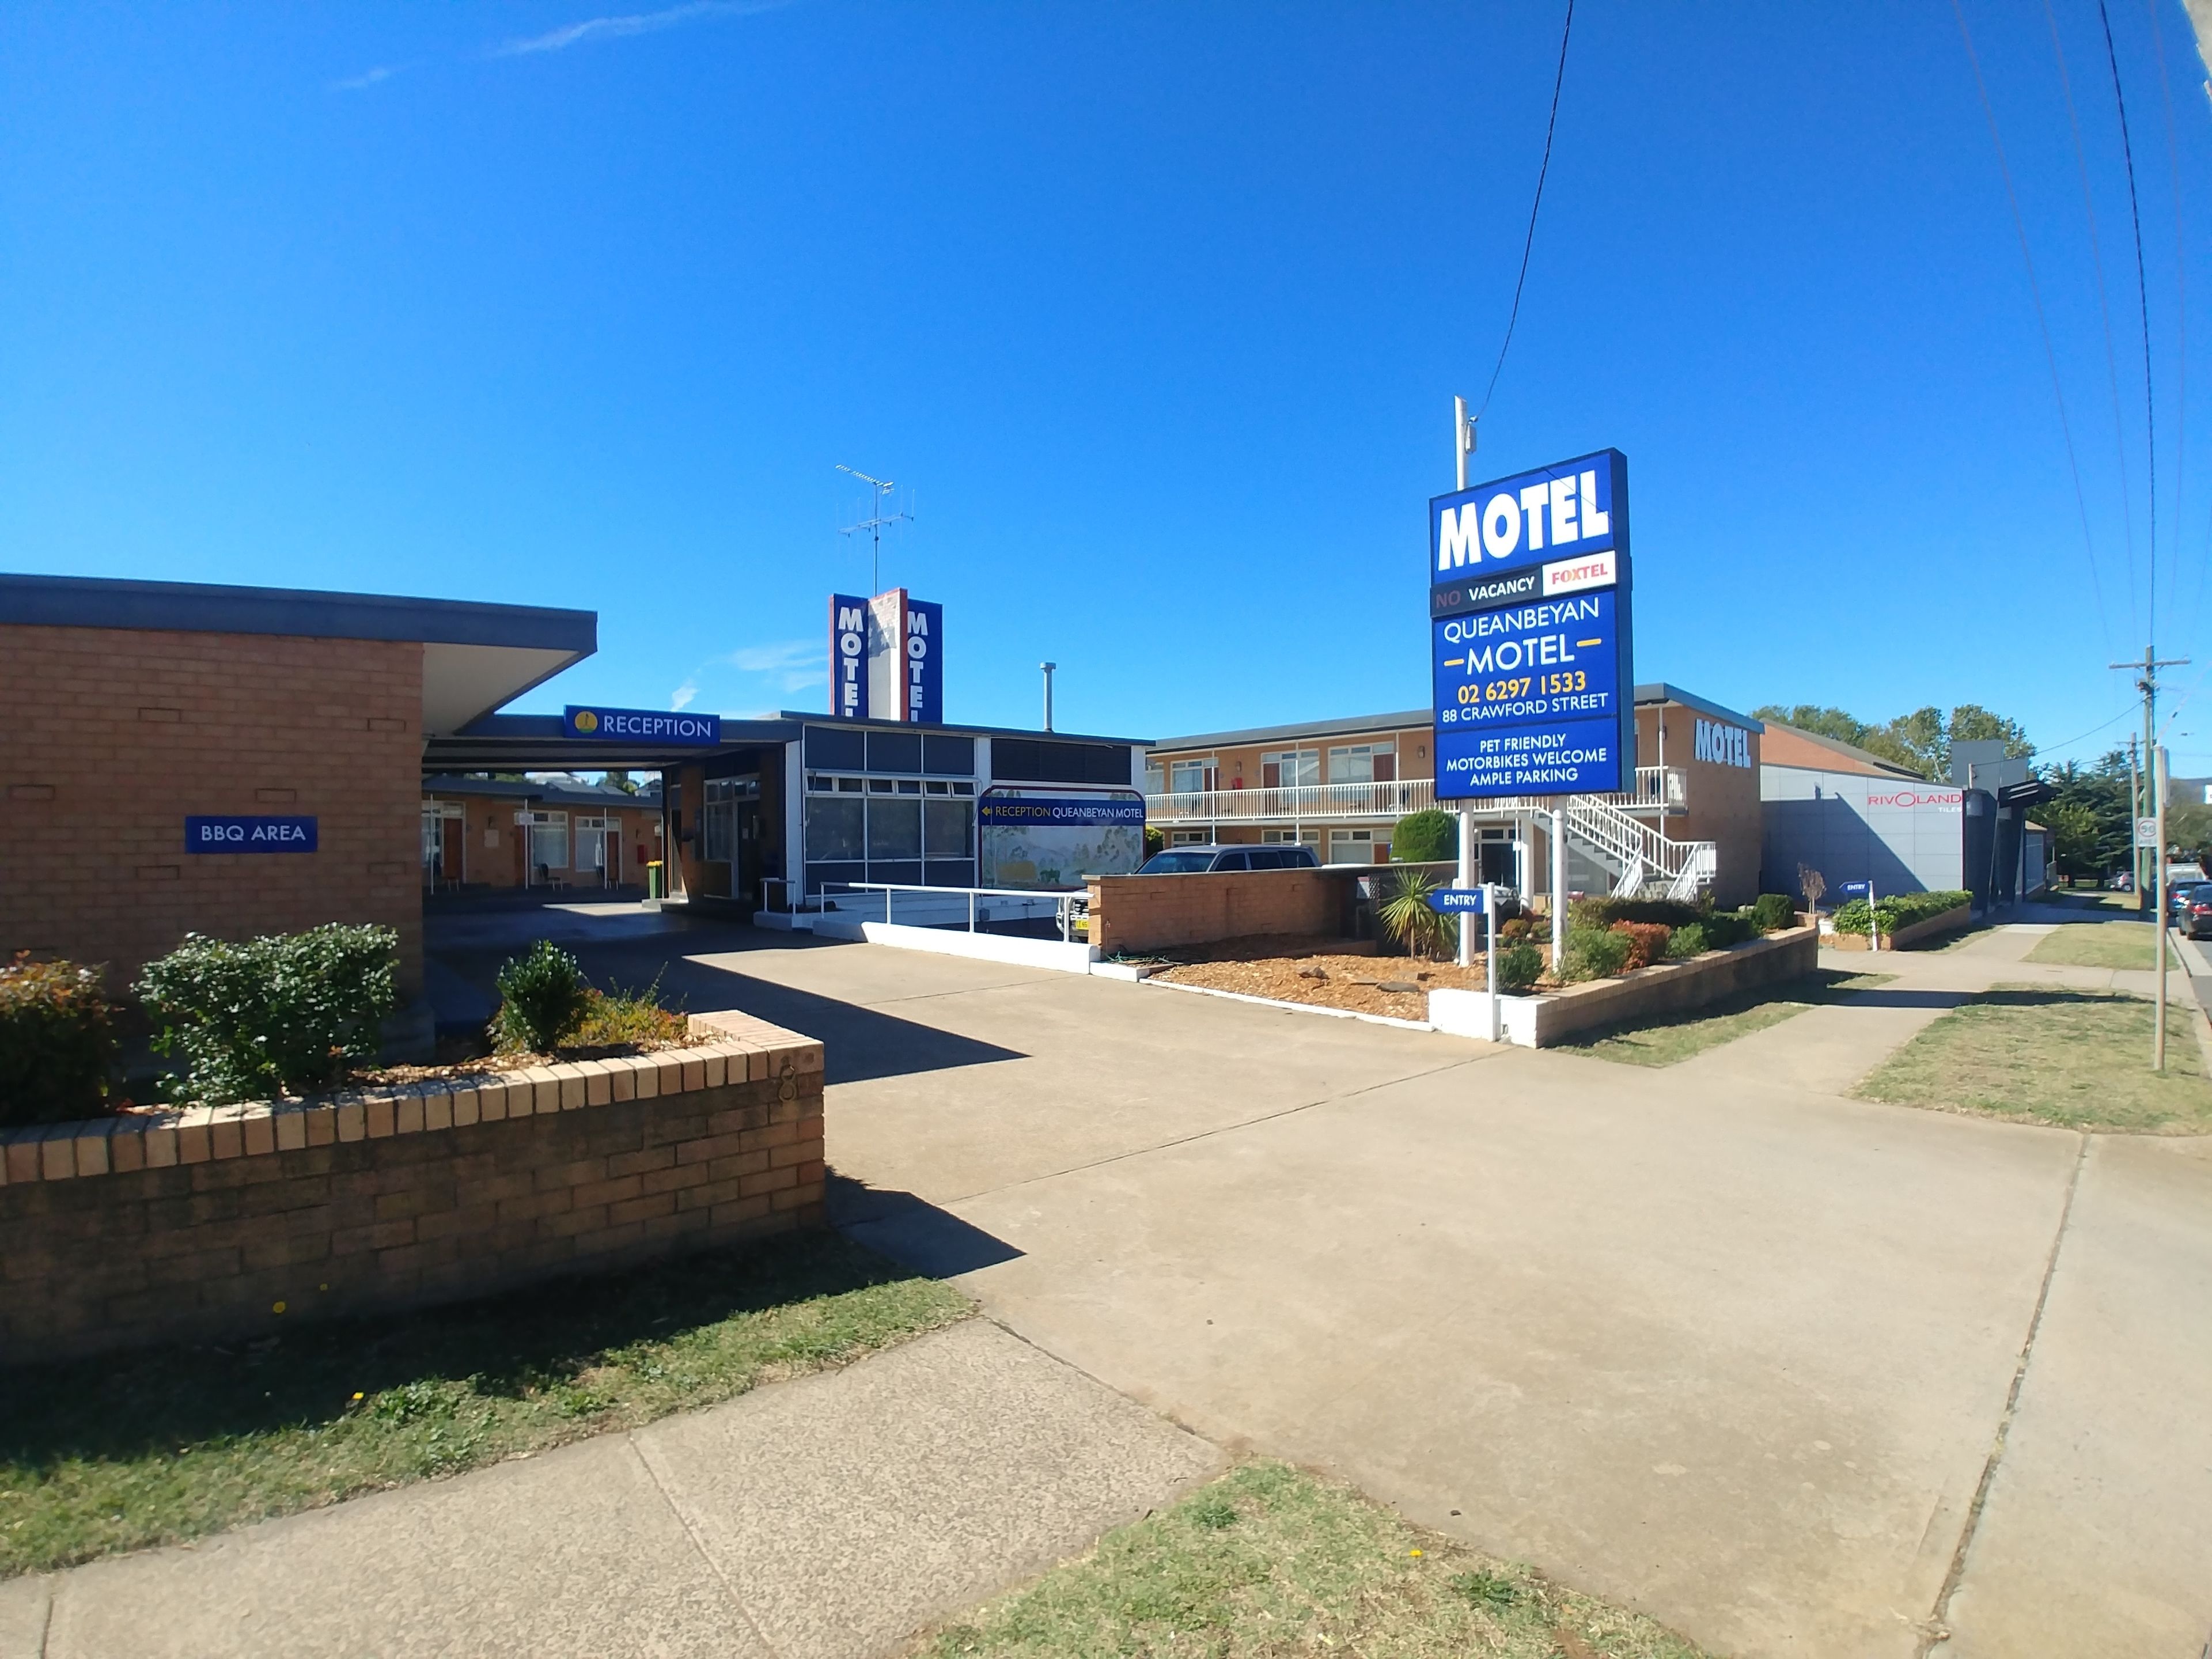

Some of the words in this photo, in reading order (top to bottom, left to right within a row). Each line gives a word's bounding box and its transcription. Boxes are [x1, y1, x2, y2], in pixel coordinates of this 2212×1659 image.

[1438, 469, 1609, 571] MOTEL
[1552, 563, 1608, 585] FOXTEL
[1436, 590, 1461, 608] NO
[1468, 576, 1535, 601] VACANCY
[1444, 597, 1599, 643] QUEANBEYAN
[1467, 633, 1575, 675] MOTEL
[1457, 684, 1480, 704] 02
[1486, 677, 1532, 700] 6297
[1540, 671, 1586, 696] 1533
[1442, 709, 1457, 723] 88
[1461, 699, 1547, 721] CRAWFORD
[1552, 692, 1609, 714] STREET
[604, 715, 711, 737] RECEPTION
[1480, 739, 1501, 753] PET
[1504, 733, 1567, 751] FRIENDLY
[1695, 718, 1751, 768] MOTEL
[1446, 752, 1529, 772] MOTORBIKES
[1533, 747, 1607, 766] WELCOME
[1470, 771, 1512, 787] AMPLE
[1516, 767, 1578, 785] PARKING
[1868, 791, 1961, 807] RIVOLAND
[995, 806, 1051, 817] RECEPTION
[1052, 807, 1114, 819] QUEANBEYAN
[1116, 808, 1143, 818] MOTEL
[202, 825, 244, 841] BBQ
[251, 825, 306, 841] AREA
[2141, 825, 2156, 834] 50
[1444, 894, 1476, 906] ENTRY
